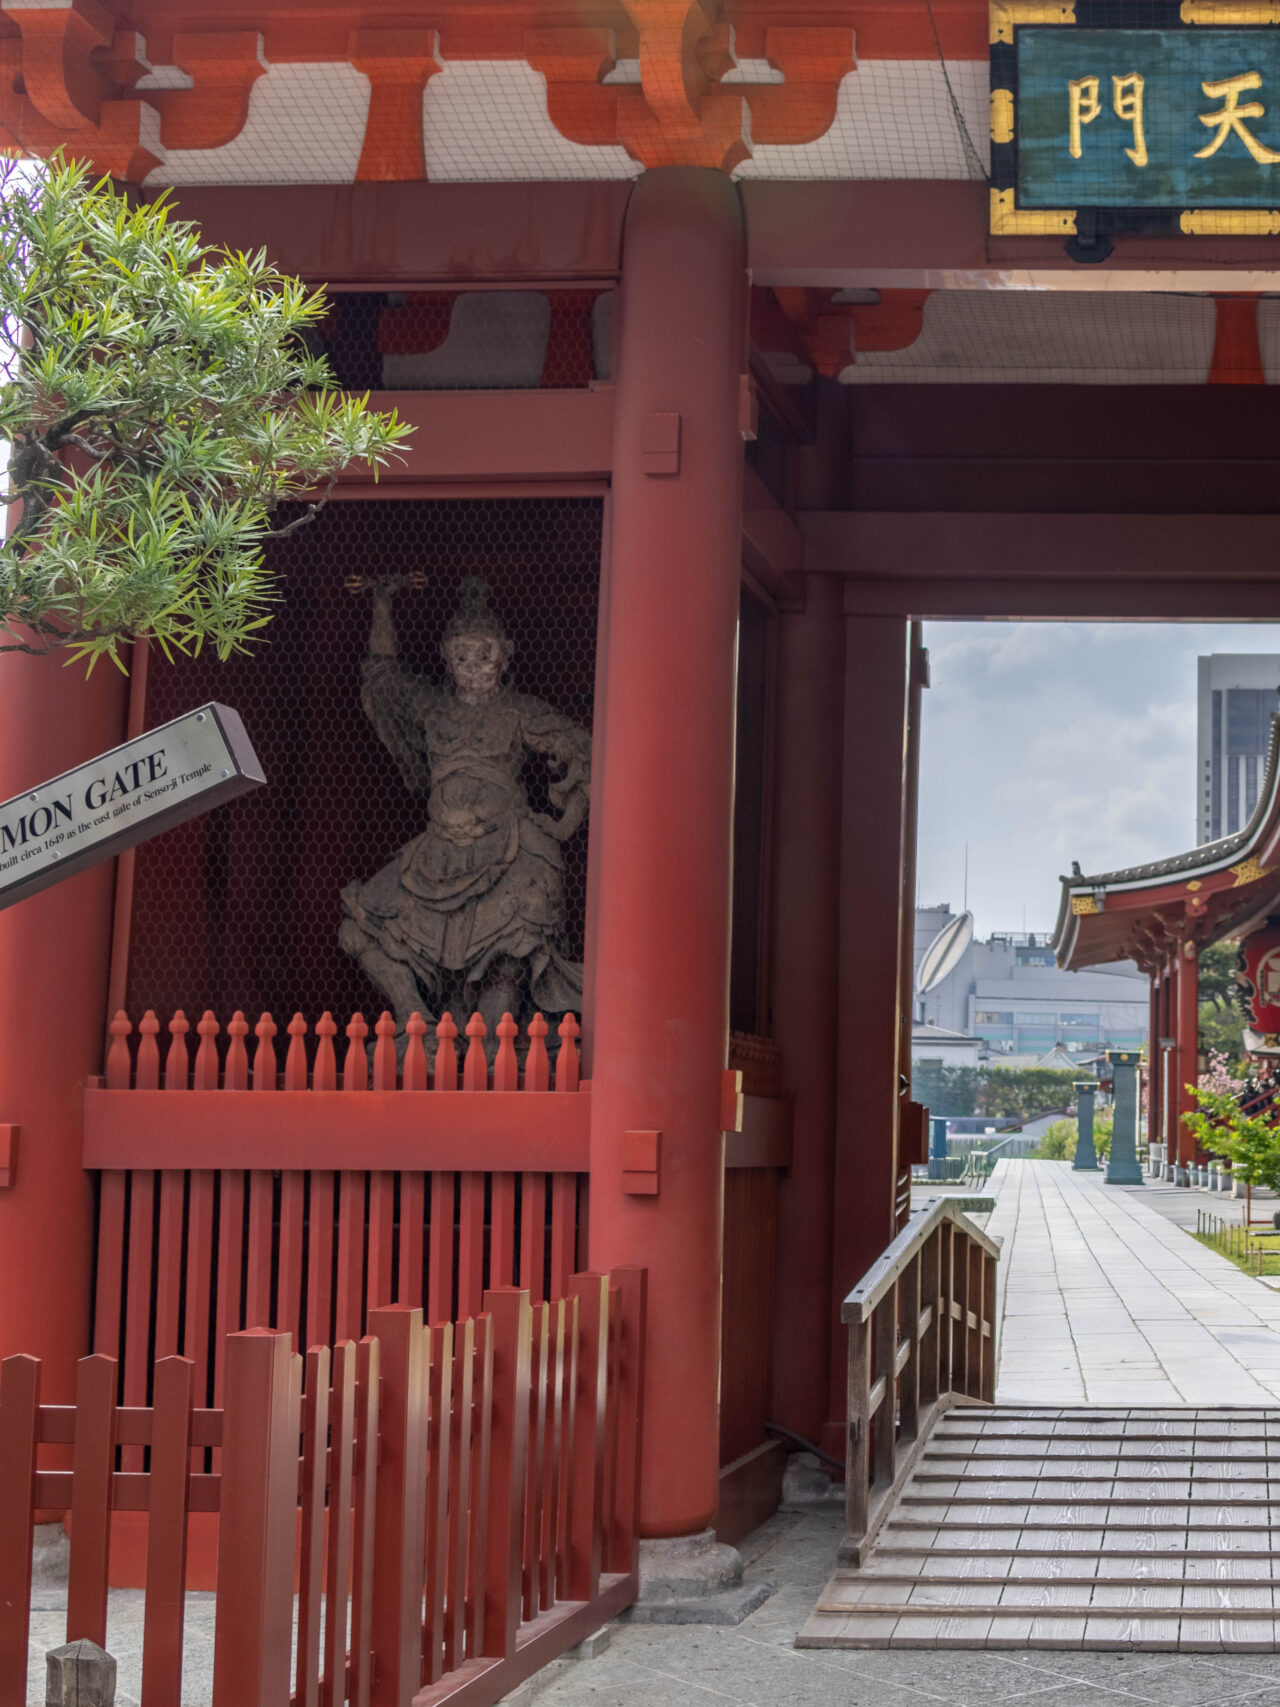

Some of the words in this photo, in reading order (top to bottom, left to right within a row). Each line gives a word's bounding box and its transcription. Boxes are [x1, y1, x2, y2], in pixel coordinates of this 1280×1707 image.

[20, 845, 42, 861] circa
[44, 832, 65, 850] 1649
[66, 829, 77, 840] as
[77, 821, 92, 834] the
[93, 811, 111, 826] east
[112, 801, 131, 818] gate
[132, 795, 142, 807] of
[178, 762, 213, 785] Temple
[85, 748, 168, 810] GATE
